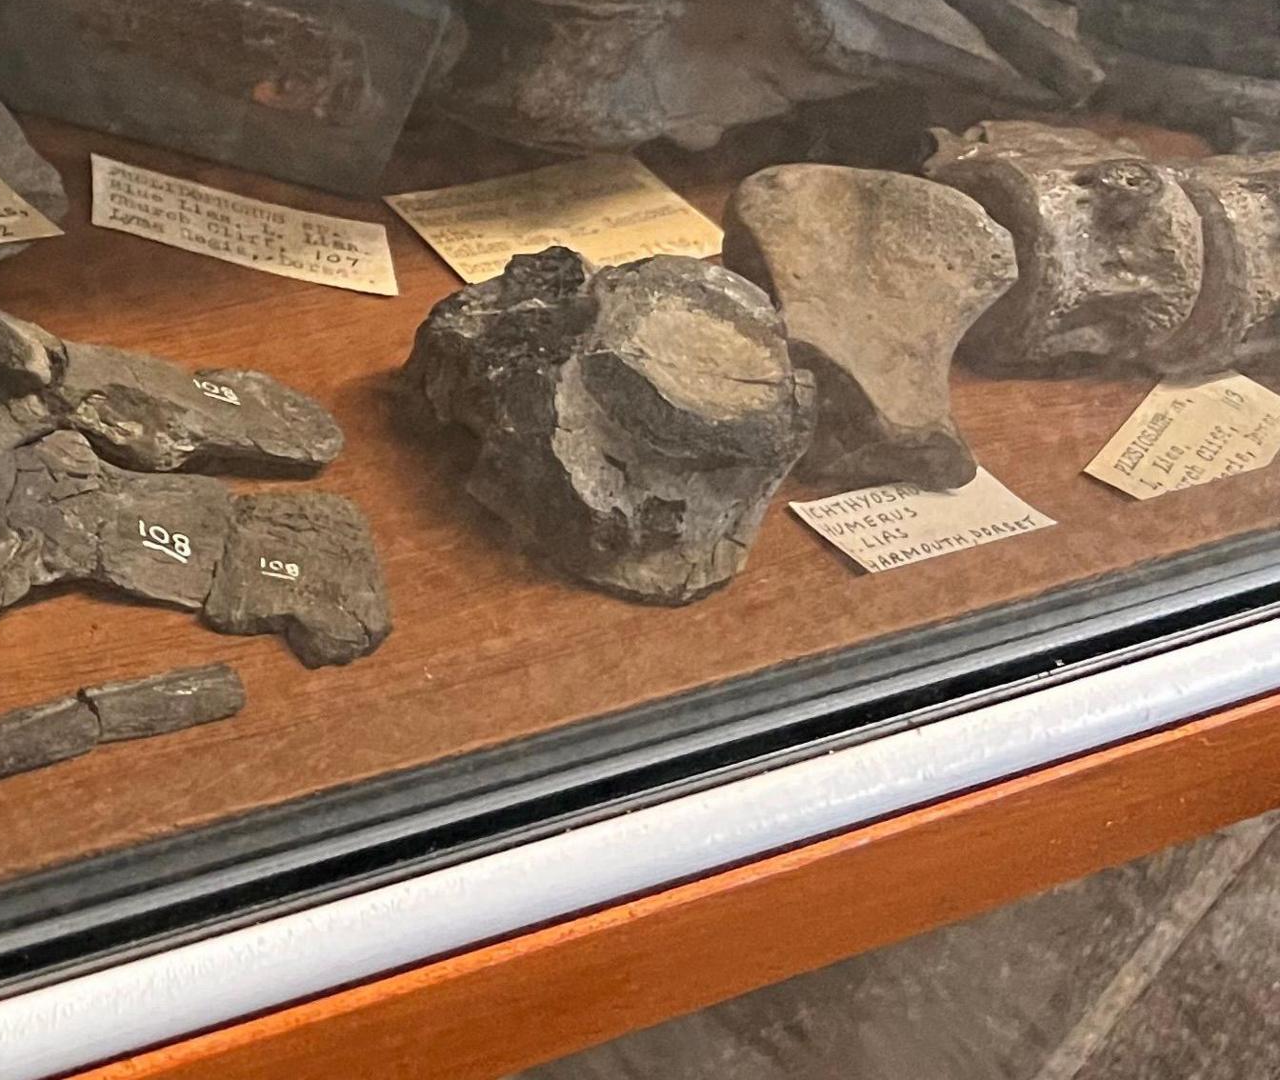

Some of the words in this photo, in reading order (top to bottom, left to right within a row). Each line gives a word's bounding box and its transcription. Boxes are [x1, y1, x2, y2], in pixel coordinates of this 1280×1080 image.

[314, 249, 359, 268] 107
[192, 378, 239, 402] 108
[823, 506, 919, 538] HUMERUS
[139, 519, 191, 557] 108
[260, 557, 300, 577] 108
